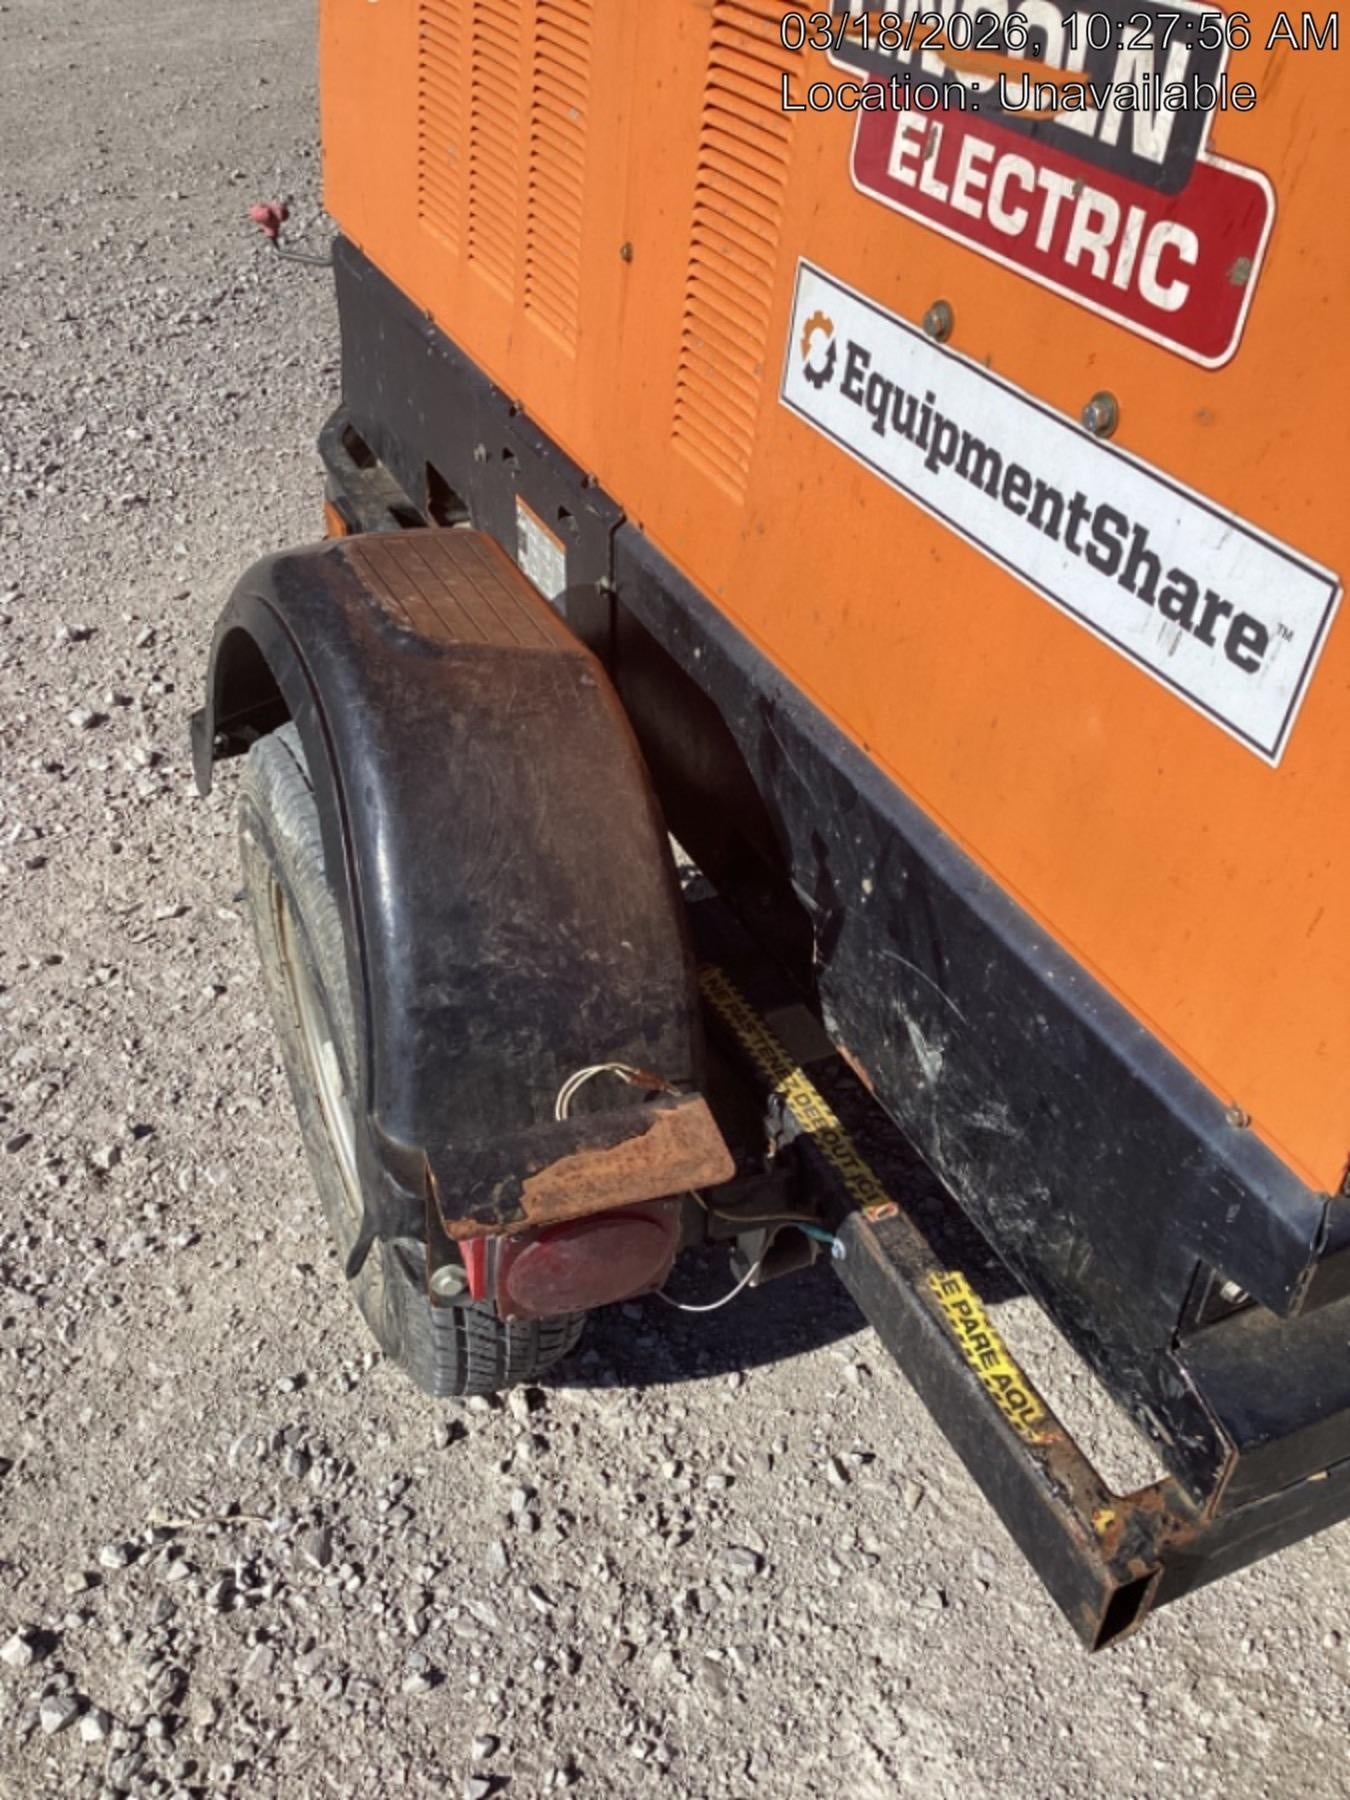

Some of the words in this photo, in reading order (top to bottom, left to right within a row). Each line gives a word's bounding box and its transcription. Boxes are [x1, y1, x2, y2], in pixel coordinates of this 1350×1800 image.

[830, 0, 1192, 165] COLN
[887, 112, 1198, 312] ELECTRIC
[840, 340, 1270, 673] EquipmentShare
[949, 1299, 1002, 1370] PARE
